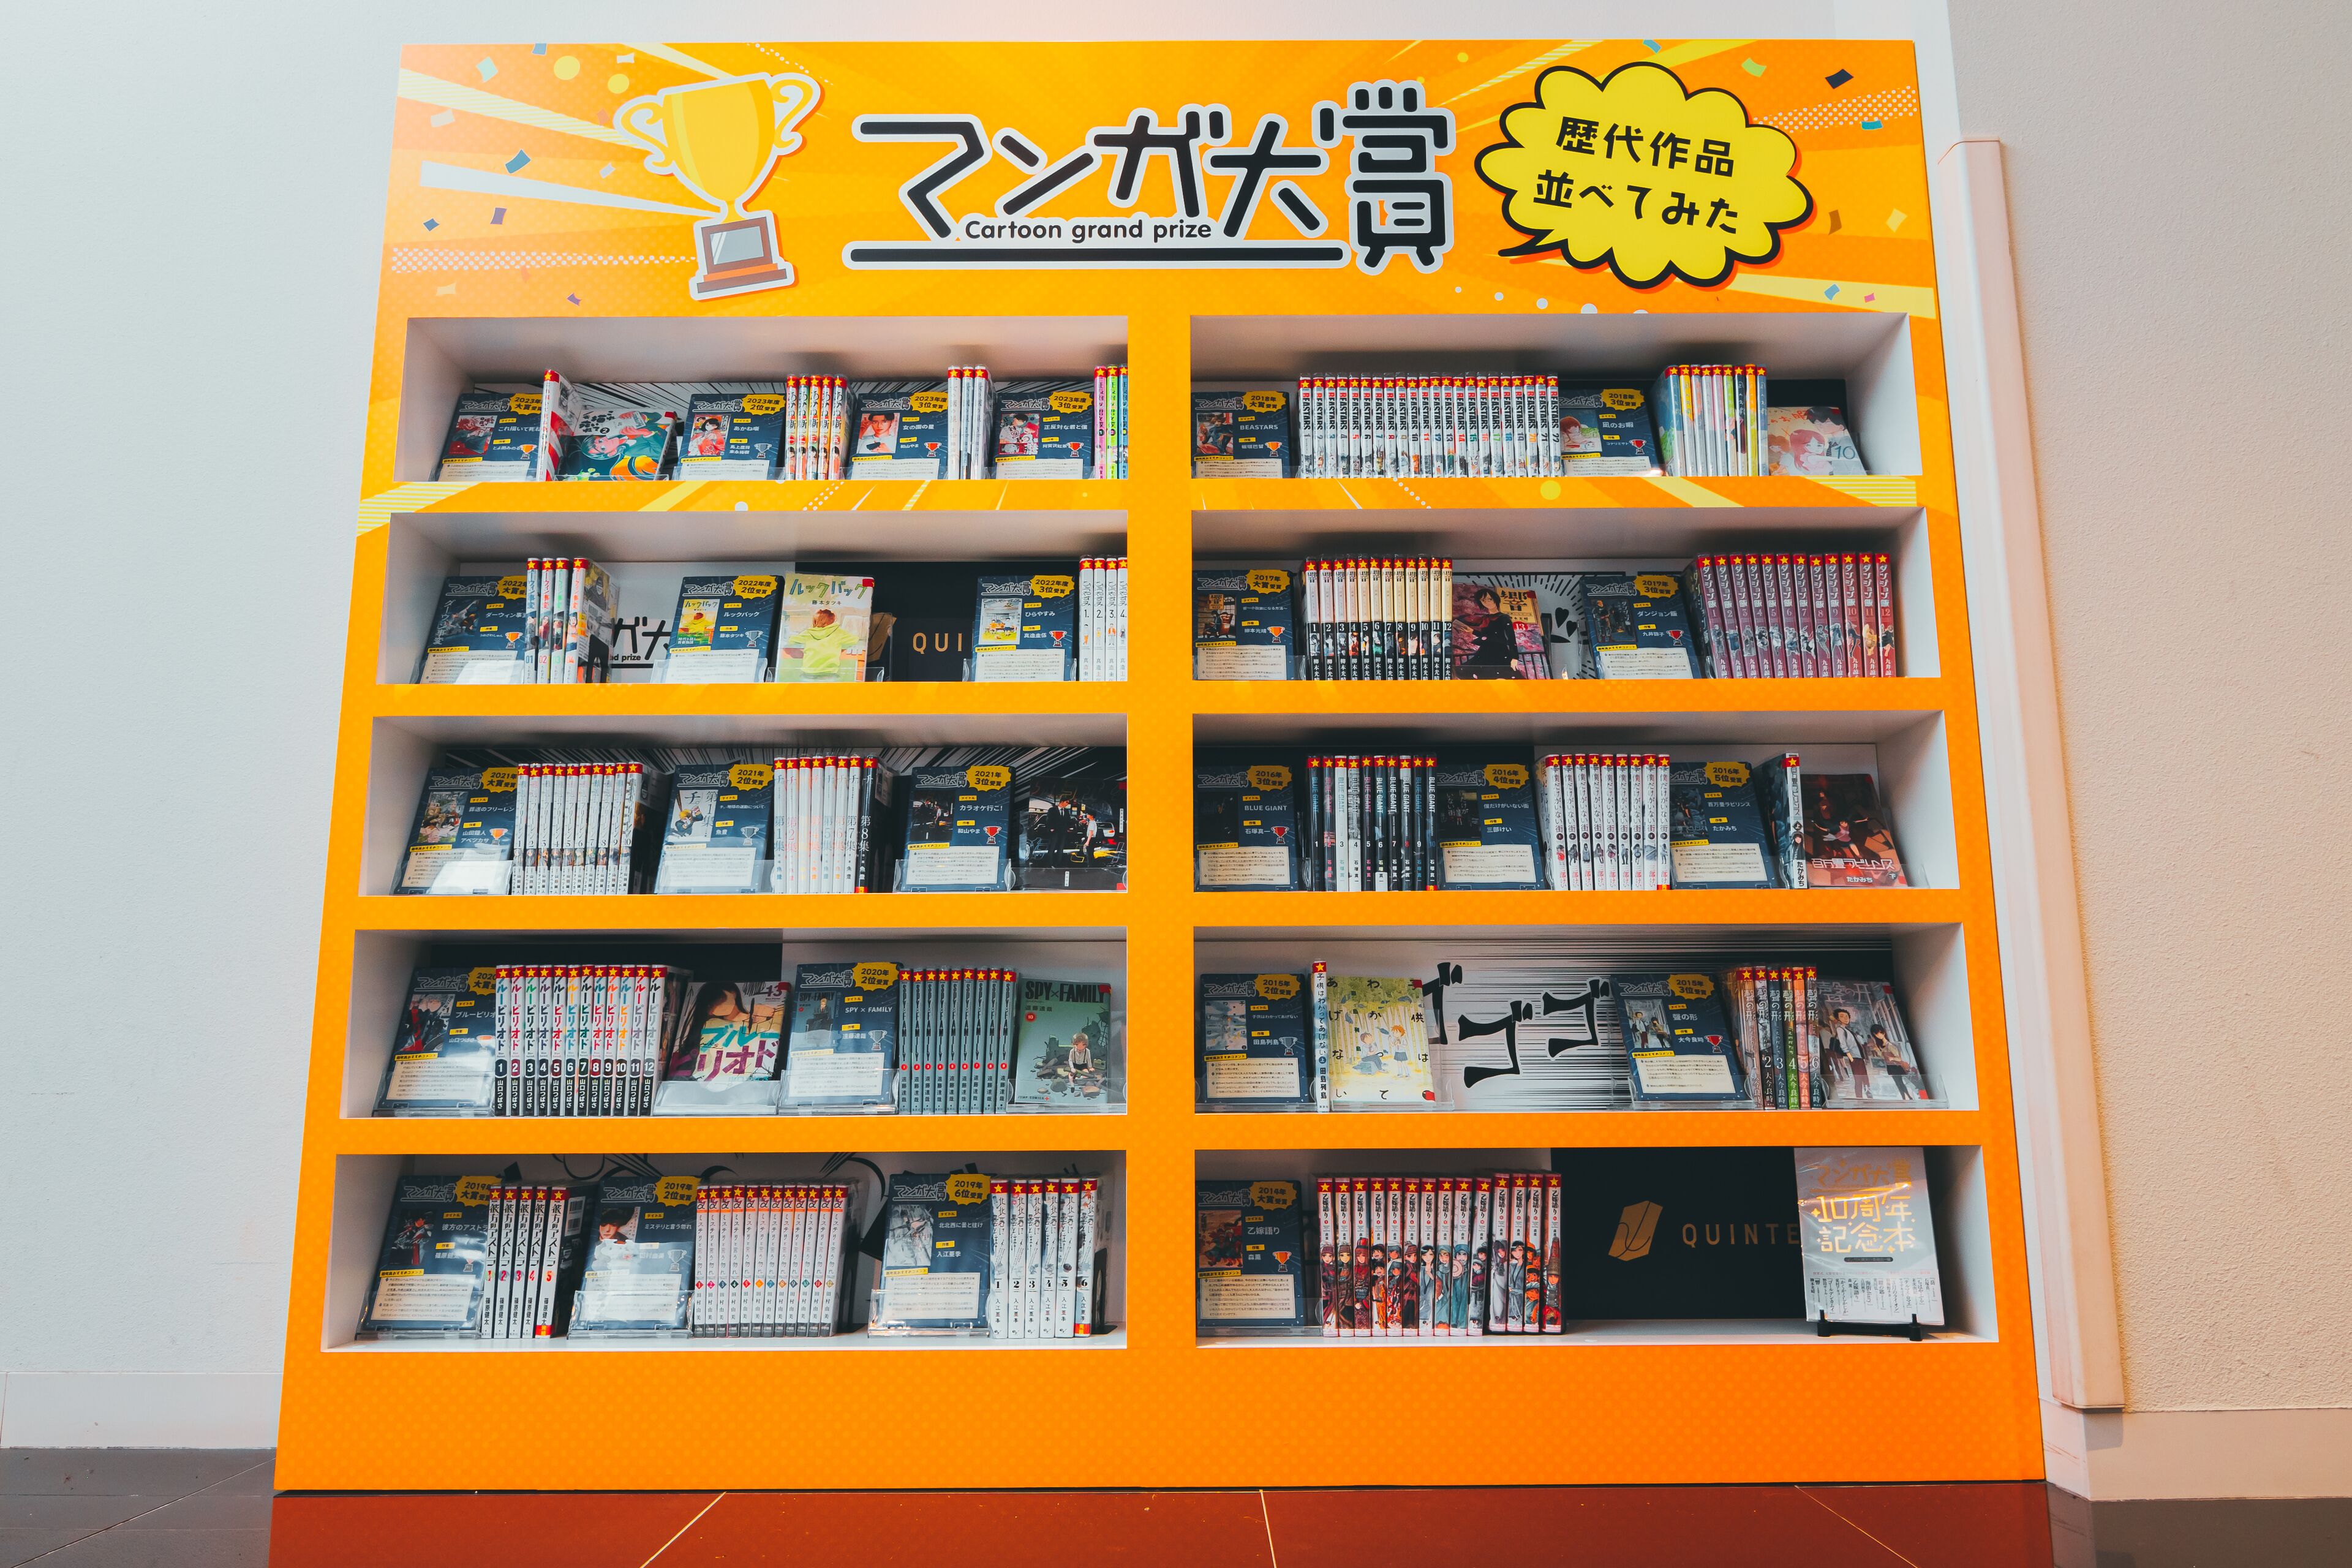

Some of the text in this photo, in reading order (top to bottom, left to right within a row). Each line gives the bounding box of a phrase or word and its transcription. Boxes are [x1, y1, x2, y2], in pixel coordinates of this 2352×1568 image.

[1556, 116, 1734, 177] 歴代作品
[855, 83, 1452, 272] マンガ大賞
[1533, 169, 1738, 234] 並べてみた
[966, 219, 1212, 243] Cartoon grand prize
[1457, 391, 1465, 431] BEASTARS
[1835, 446, 1855, 460] 10
[790, 578, 868, 600] ルックバック
[1340, 623, 1344, 631] 3
[913, 633, 962, 654] QUI
[487, 779, 516, 788] 大賞受賞
[861, 976, 889, 985] 2位受賞
[1264, 987, 1291, 995] 2位受賞
[513, 1063, 518, 1072] 2
[527, 1063, 533, 1072] 3
[554, 1063, 559, 1072] 5
[1789, 1057, 1796, 1068] 4
[1812, 1057, 1819, 1068] 6
[665, 1182, 693, 1191] 2019年
[663, 1191, 692, 1200] 2位受賞
[955, 1189, 982, 1199] 6位受賞
[1257, 1195, 1287, 1205] 大賞受賞
[1247, 1226, 1280, 1235] 乙嫁語り
[1819, 1222, 1915, 1253] 記念本
